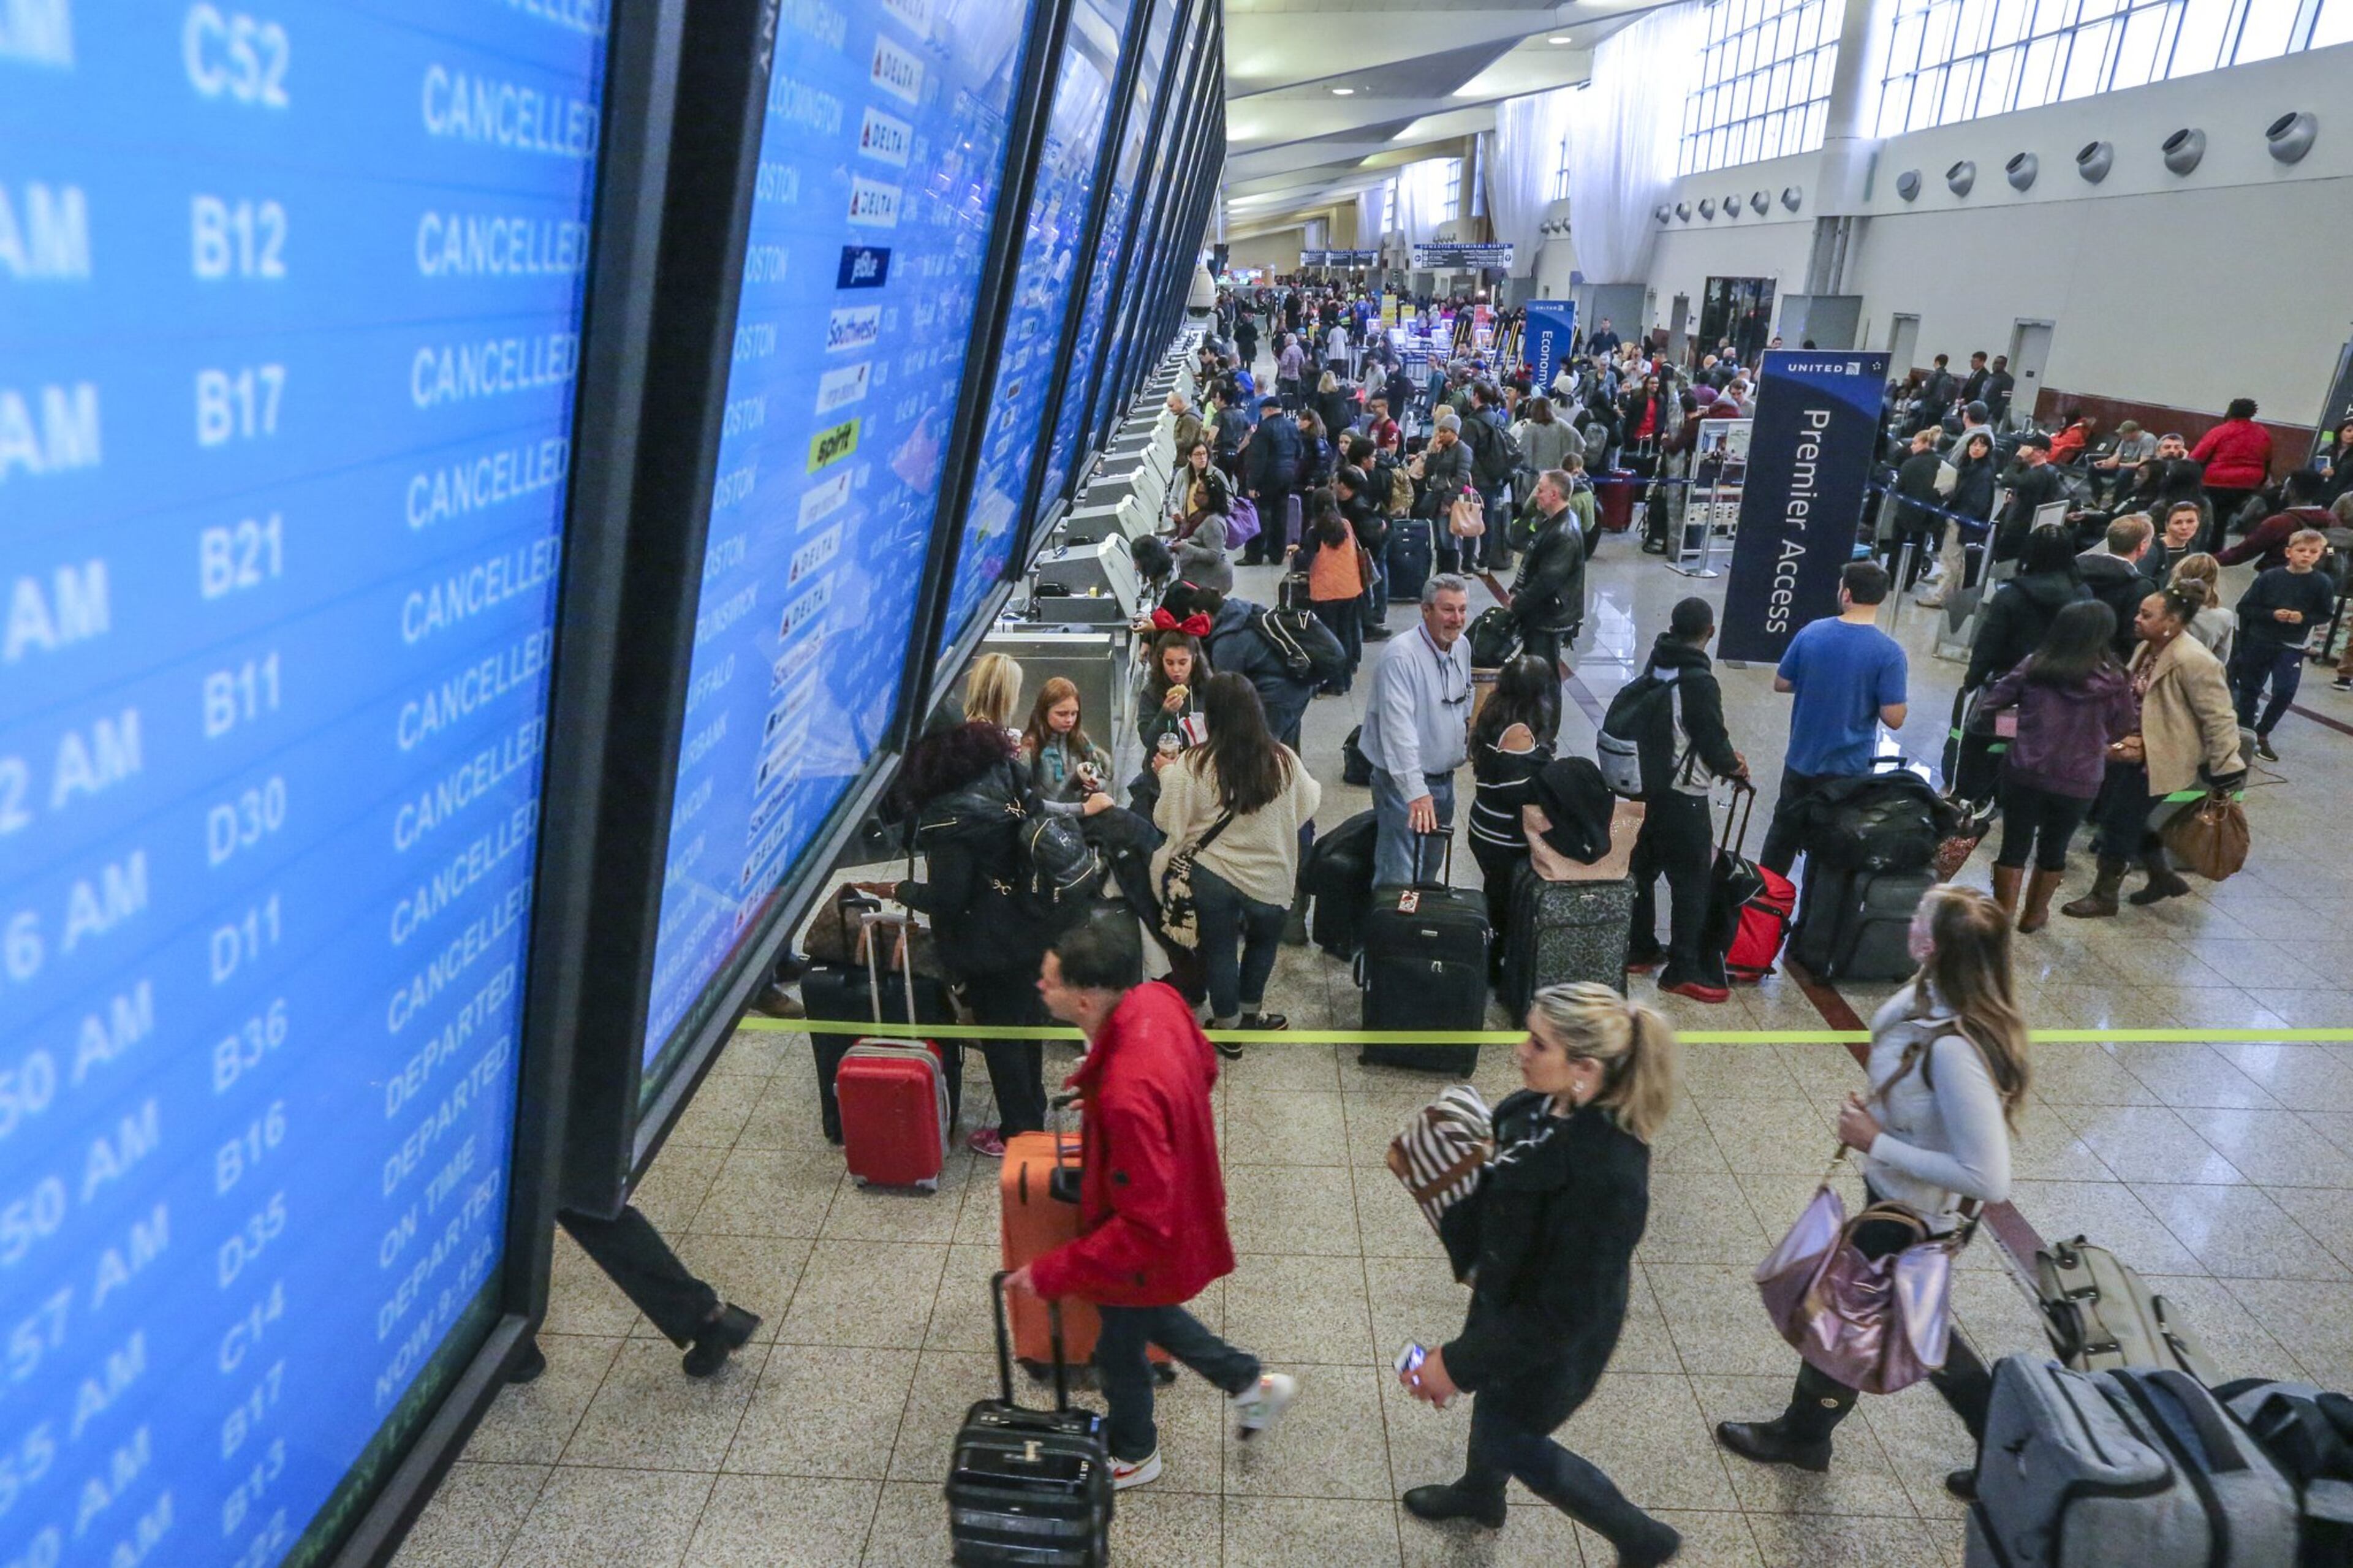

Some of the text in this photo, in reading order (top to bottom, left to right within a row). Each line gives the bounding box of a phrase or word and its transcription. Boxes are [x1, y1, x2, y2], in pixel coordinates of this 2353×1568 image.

[182, 4, 291, 108] C52
[422, 63, 599, 159] CANCELLED
[870, 121, 904, 157] DELTA
[882, 50, 915, 93] DELTA
[190, 194, 287, 279] B12
[415, 211, 588, 277] CANCELLED
[860, 190, 892, 221] DELTA
[196, 365, 286, 449] B17
[412, 333, 578, 409] CANCELLED
[1536, 330, 1553, 390] Economy
[1788, 364, 1843, 373] UNITED
[815, 420, 853, 470] spirit
[1766, 410, 1830, 633] Premier Access
[2, 436, 570, 662] AM B21 CANCELLED
[790, 583, 825, 630] DELTA
[799, 533, 834, 575] DELTA
[50, 707, 142, 810] AM
[203, 651, 279, 739] B11
[401, 535, 561, 645] CANCELLED
[63, 850, 147, 953] AM
[208, 776, 286, 866] D30
[397, 626, 553, 752] CANCELLED
[73, 979, 153, 1086] AM
[211, 893, 281, 986] D11
[393, 714, 546, 853] CANCELLED
[81, 1099, 159, 1205] AM
[214, 998, 287, 1095] B36
[390, 795, 539, 947] CANCELLED
[91, 1203, 169, 1311] AM
[216, 1101, 286, 1194] B16
[388, 875, 532, 1034] CANCELLED
[71, 1330, 145, 1440] AM
[218, 1191, 287, 1290] D35
[385, 960, 516, 1120] DEPARTED
[74, 1424, 150, 1537] AM
[219, 1279, 284, 1374] C14
[383, 1034, 510, 1198] DEPARTED
[222, 1360, 286, 1460] B17
[379, 1202, 417, 1270] ON
[425, 1135, 477, 1216] TIME
[222, 1169, 500, 1537] B13 DEPARTED
[375, 1309, 436, 1411] NOW
